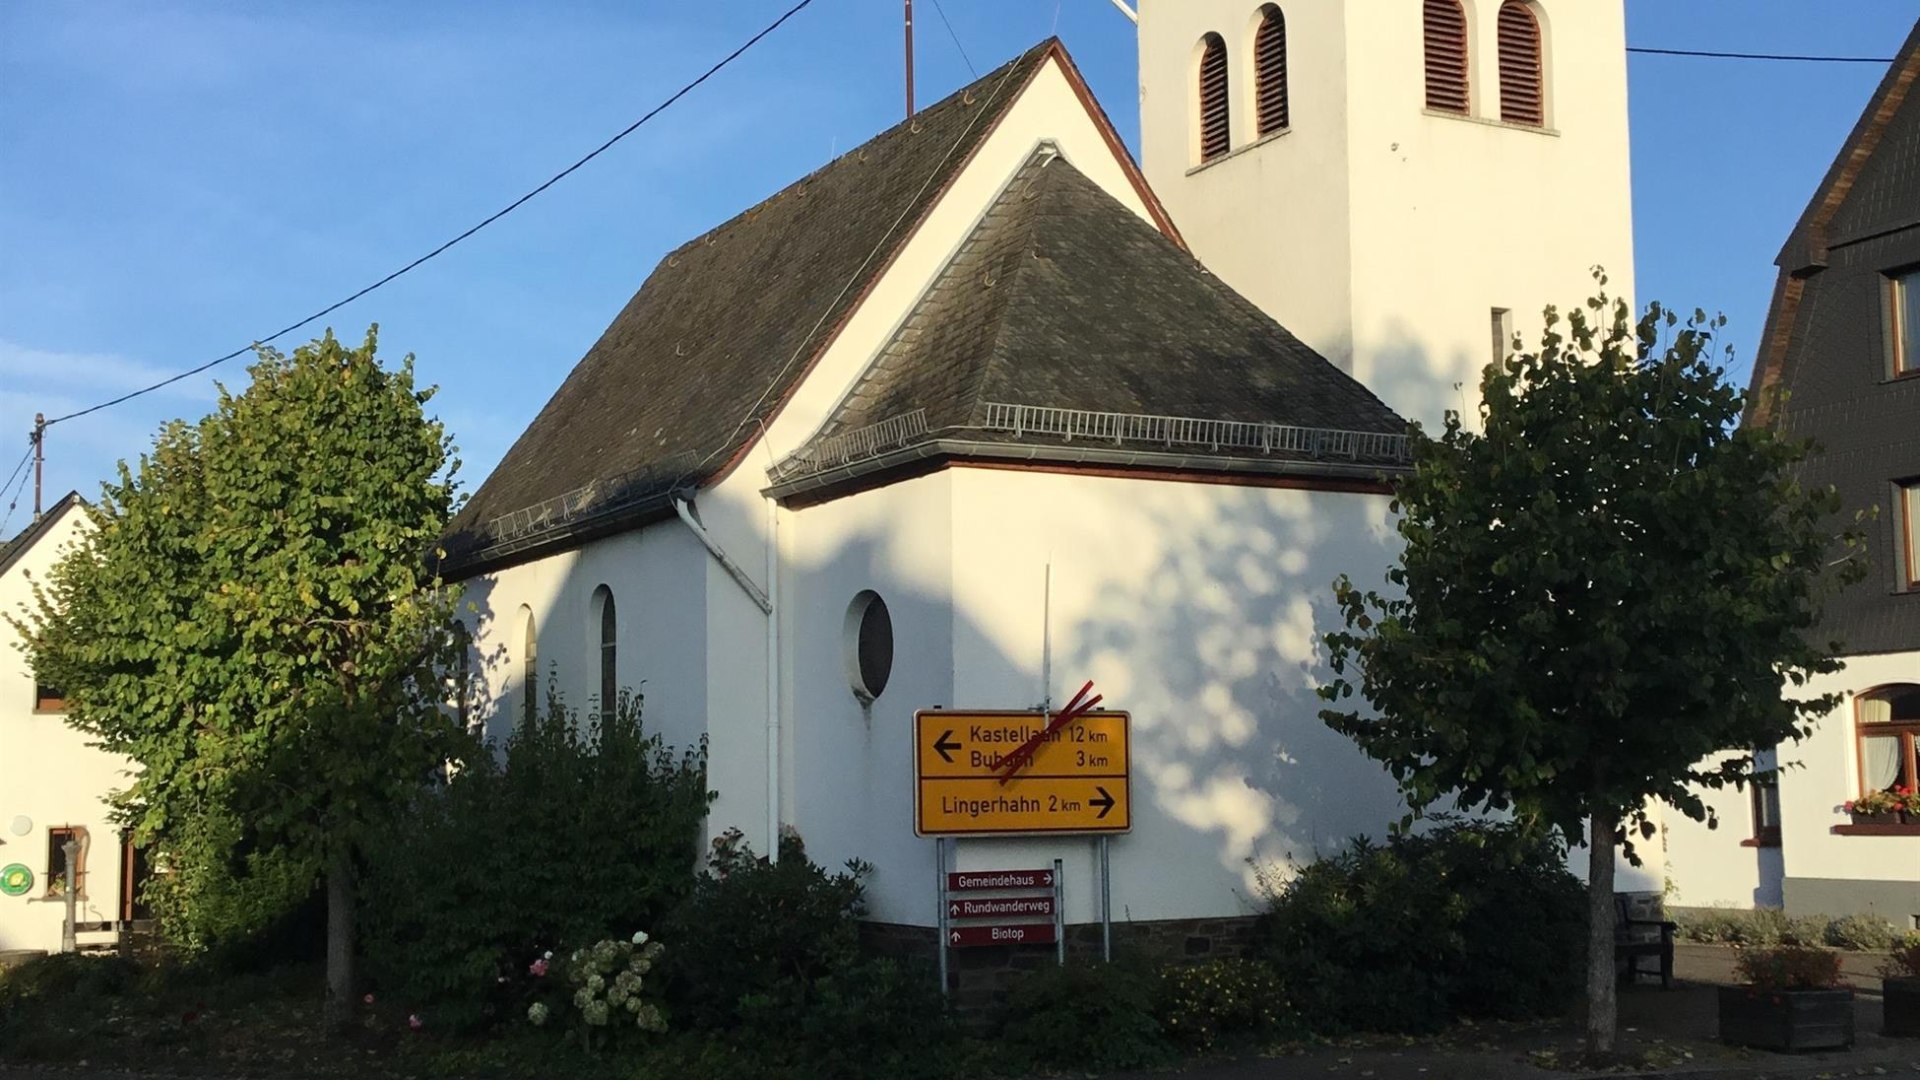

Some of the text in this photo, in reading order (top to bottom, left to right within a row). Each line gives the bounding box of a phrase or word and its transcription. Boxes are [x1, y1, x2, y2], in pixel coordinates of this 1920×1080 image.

[1069, 726, 1085, 742] 12
[1089, 730, 1107, 742] km
[1076, 750, 1085, 767] 3
[1089, 754, 1108, 767] km
[943, 795, 1081, 817] Lingerhahn 2 km
[958, 874, 1035, 888] Gemeindehaus
[964, 901, 1050, 914] Rundwanderweg
[991, 927, 1025, 941] Biotop
